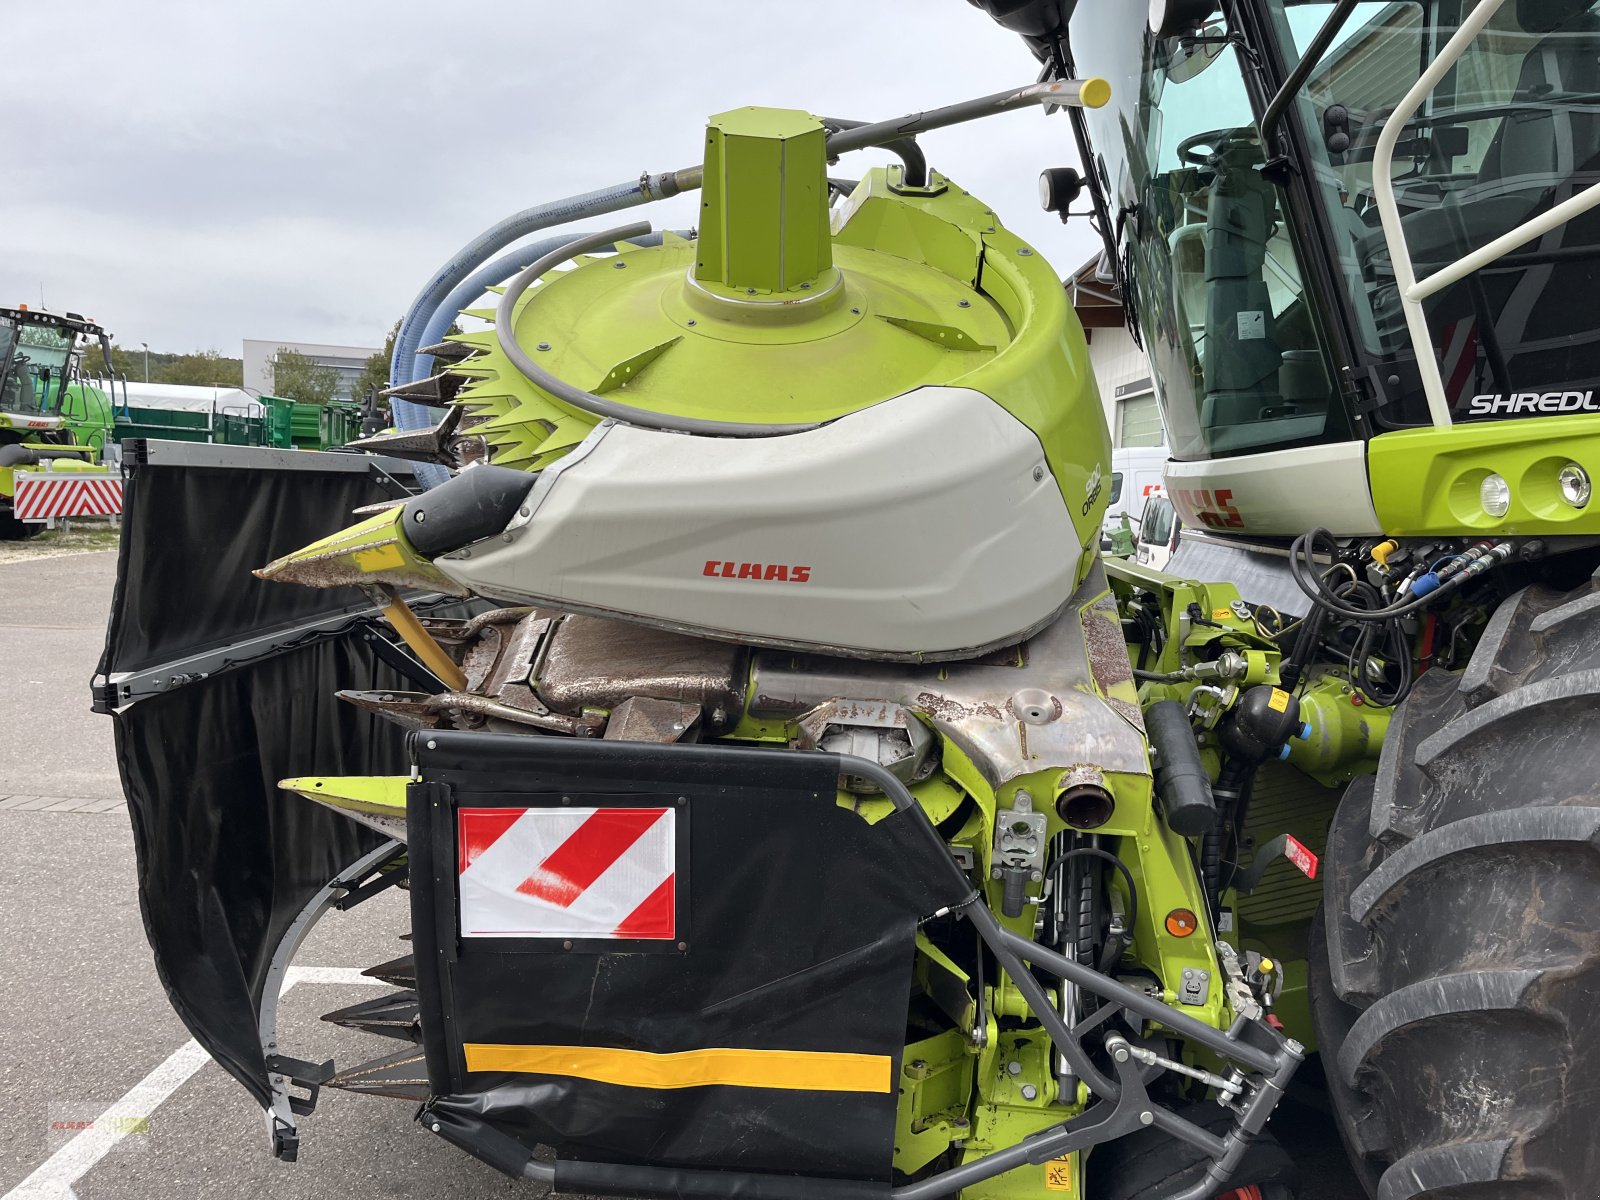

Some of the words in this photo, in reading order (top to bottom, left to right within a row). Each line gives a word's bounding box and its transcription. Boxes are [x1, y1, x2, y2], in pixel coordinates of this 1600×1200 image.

[1469, 391, 1600, 415] SHREDL
[1086, 462, 1101, 497] 900
[1082, 477, 1101, 516] ORBIS
[703, 560, 811, 583] CLAAS
